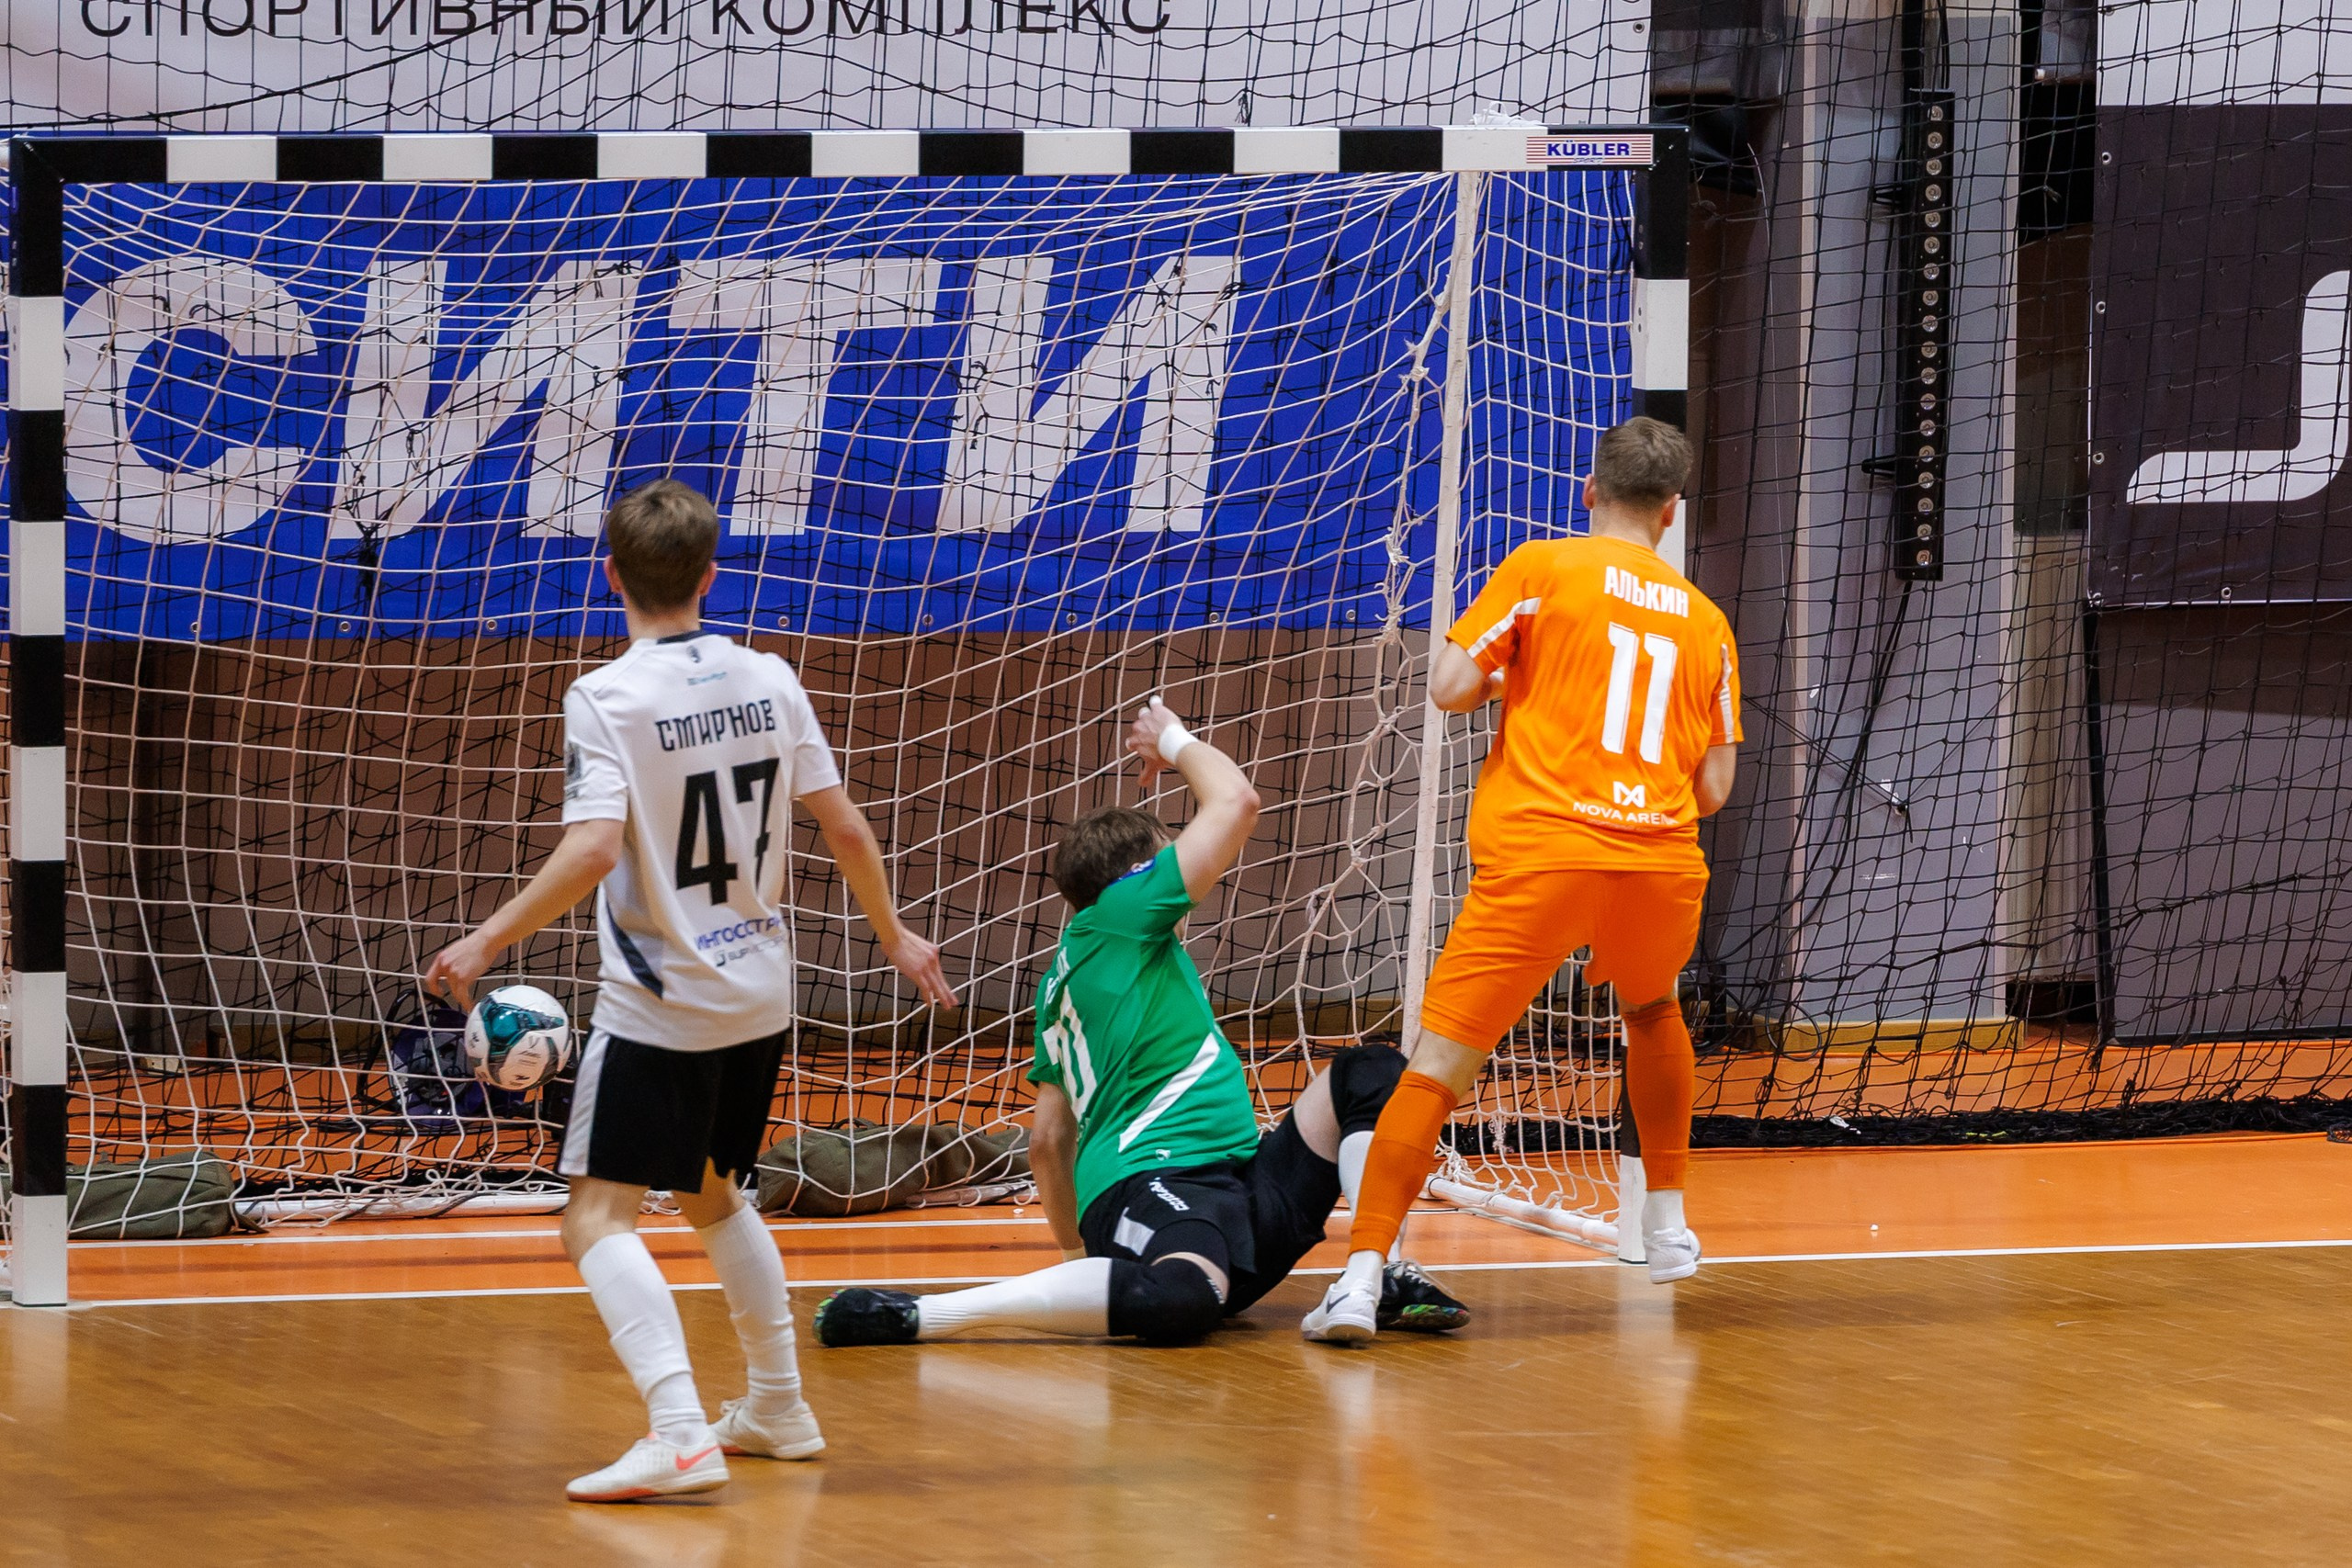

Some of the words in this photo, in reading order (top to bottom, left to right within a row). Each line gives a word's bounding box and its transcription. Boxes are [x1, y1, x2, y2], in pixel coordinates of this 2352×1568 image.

[1547, 140, 1631, 157] KÜBLER
[64, 255, 1244, 546] СИТИ
[1603, 565, 1689, 618] АЛЬКИН
[1600, 621, 1678, 764] 11
[655, 698, 776, 752] СМИРНОВ
[675, 757, 780, 907] 47
[1572, 801, 1623, 821] NOVA
